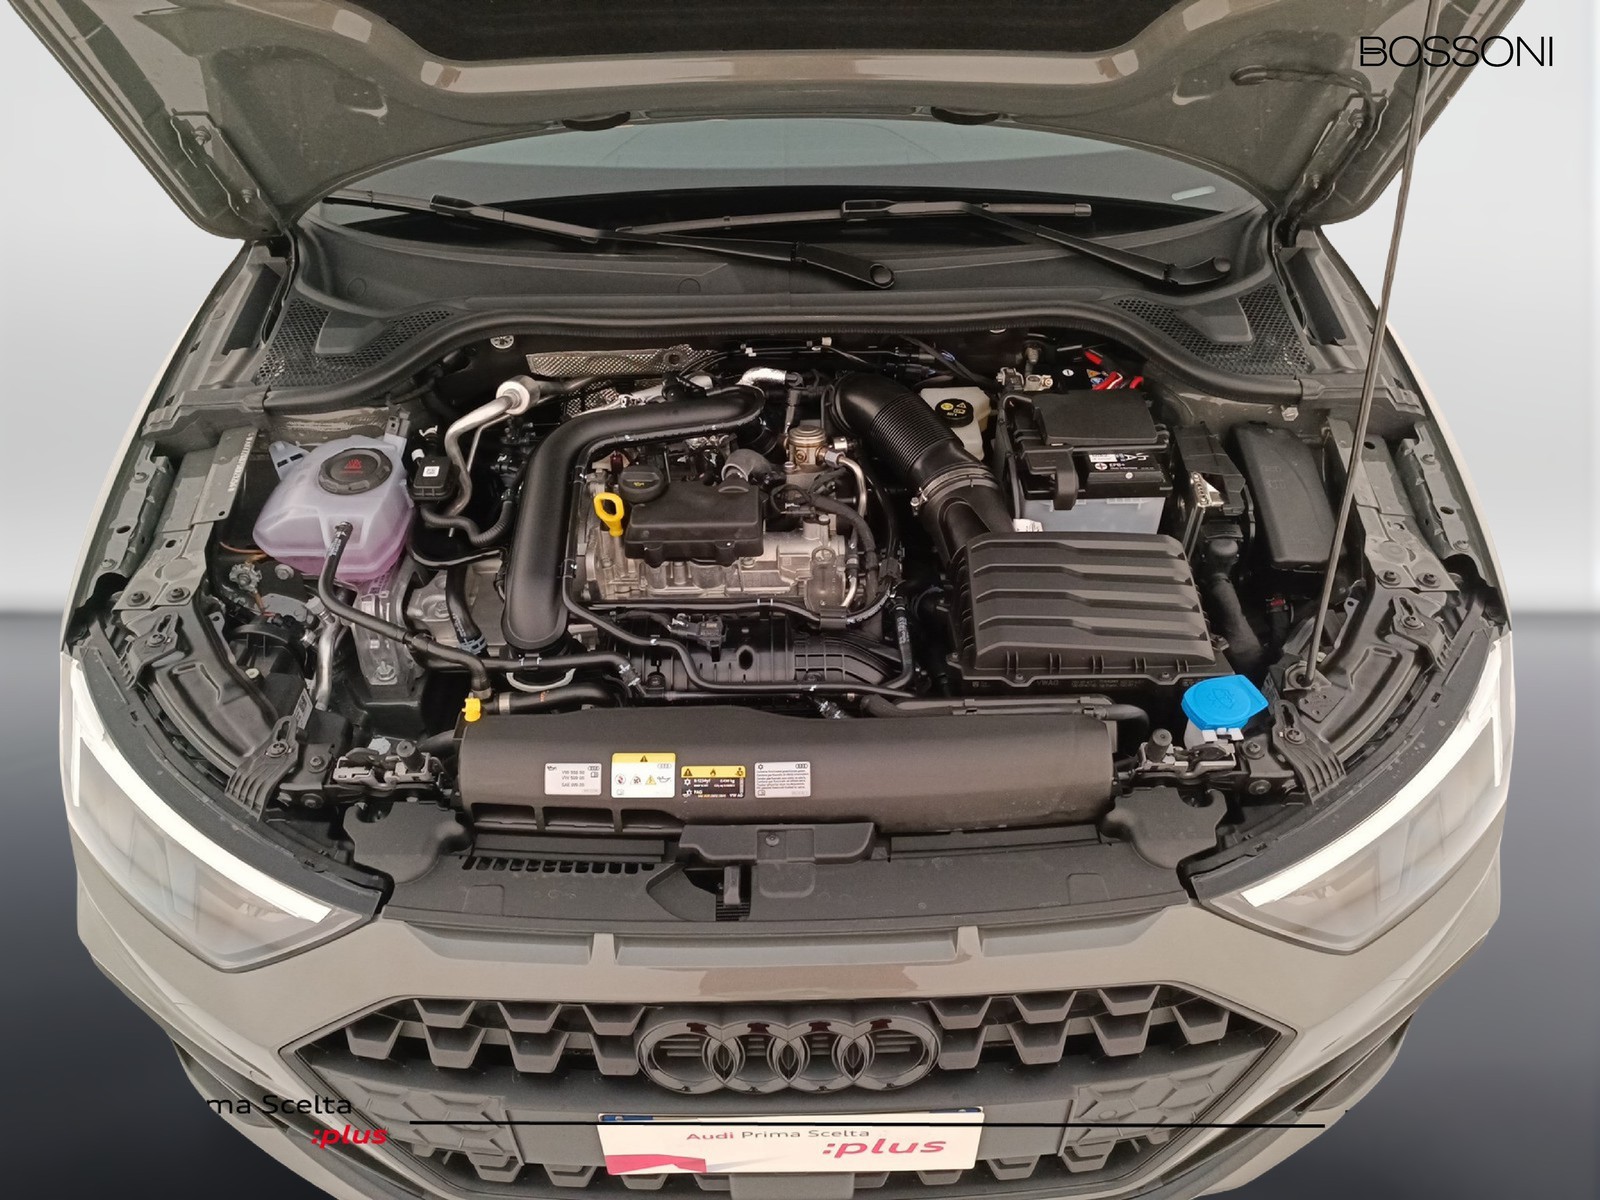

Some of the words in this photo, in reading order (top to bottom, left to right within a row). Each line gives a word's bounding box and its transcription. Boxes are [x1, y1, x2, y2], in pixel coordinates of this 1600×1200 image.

[686, 1131, 734, 1140] Audi
[742, 1130, 800, 1139] Prima
[808, 1129, 870, 1138] Scelta
